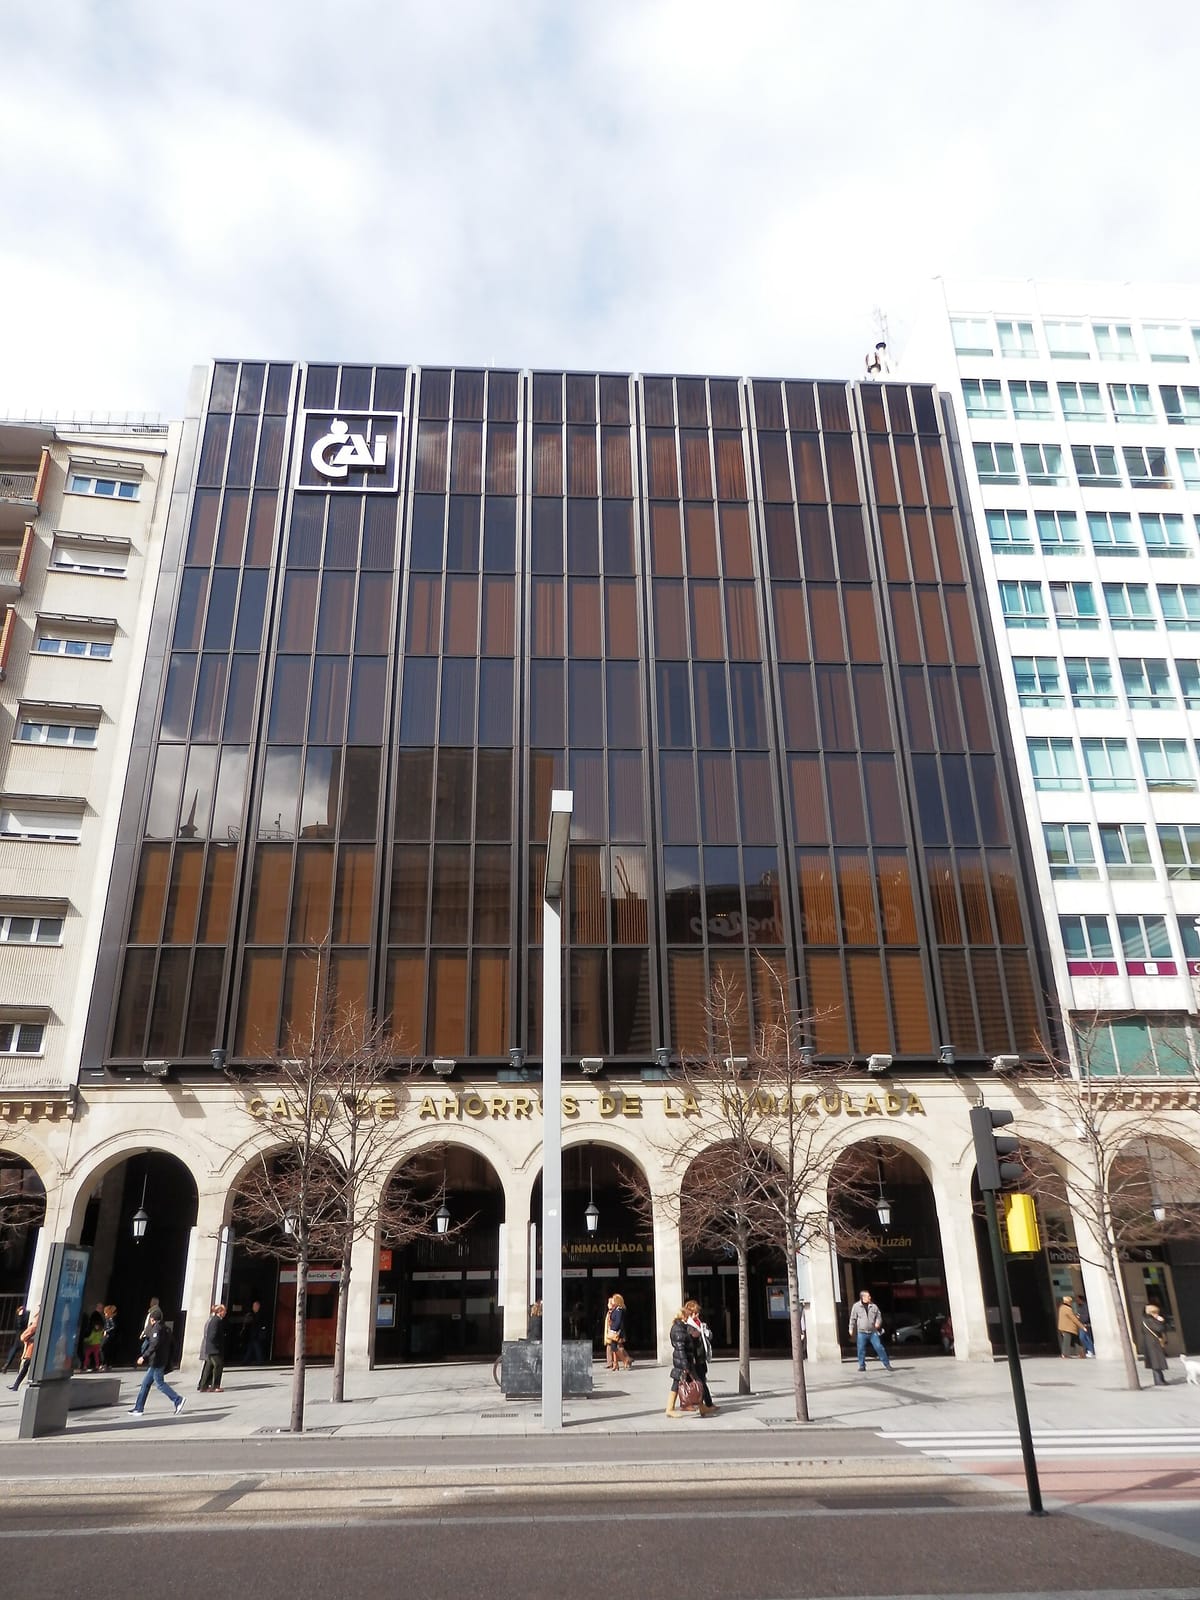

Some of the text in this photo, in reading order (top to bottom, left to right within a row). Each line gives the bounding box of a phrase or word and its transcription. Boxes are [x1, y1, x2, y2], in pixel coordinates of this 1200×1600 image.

[311, 430, 387, 477] CAI
[248, 1095, 329, 1116] CAA
[599, 1094, 641, 1115] DE
[664, 1093, 701, 1114] LA
[571, 1243, 643, 1254] INMACULADA
